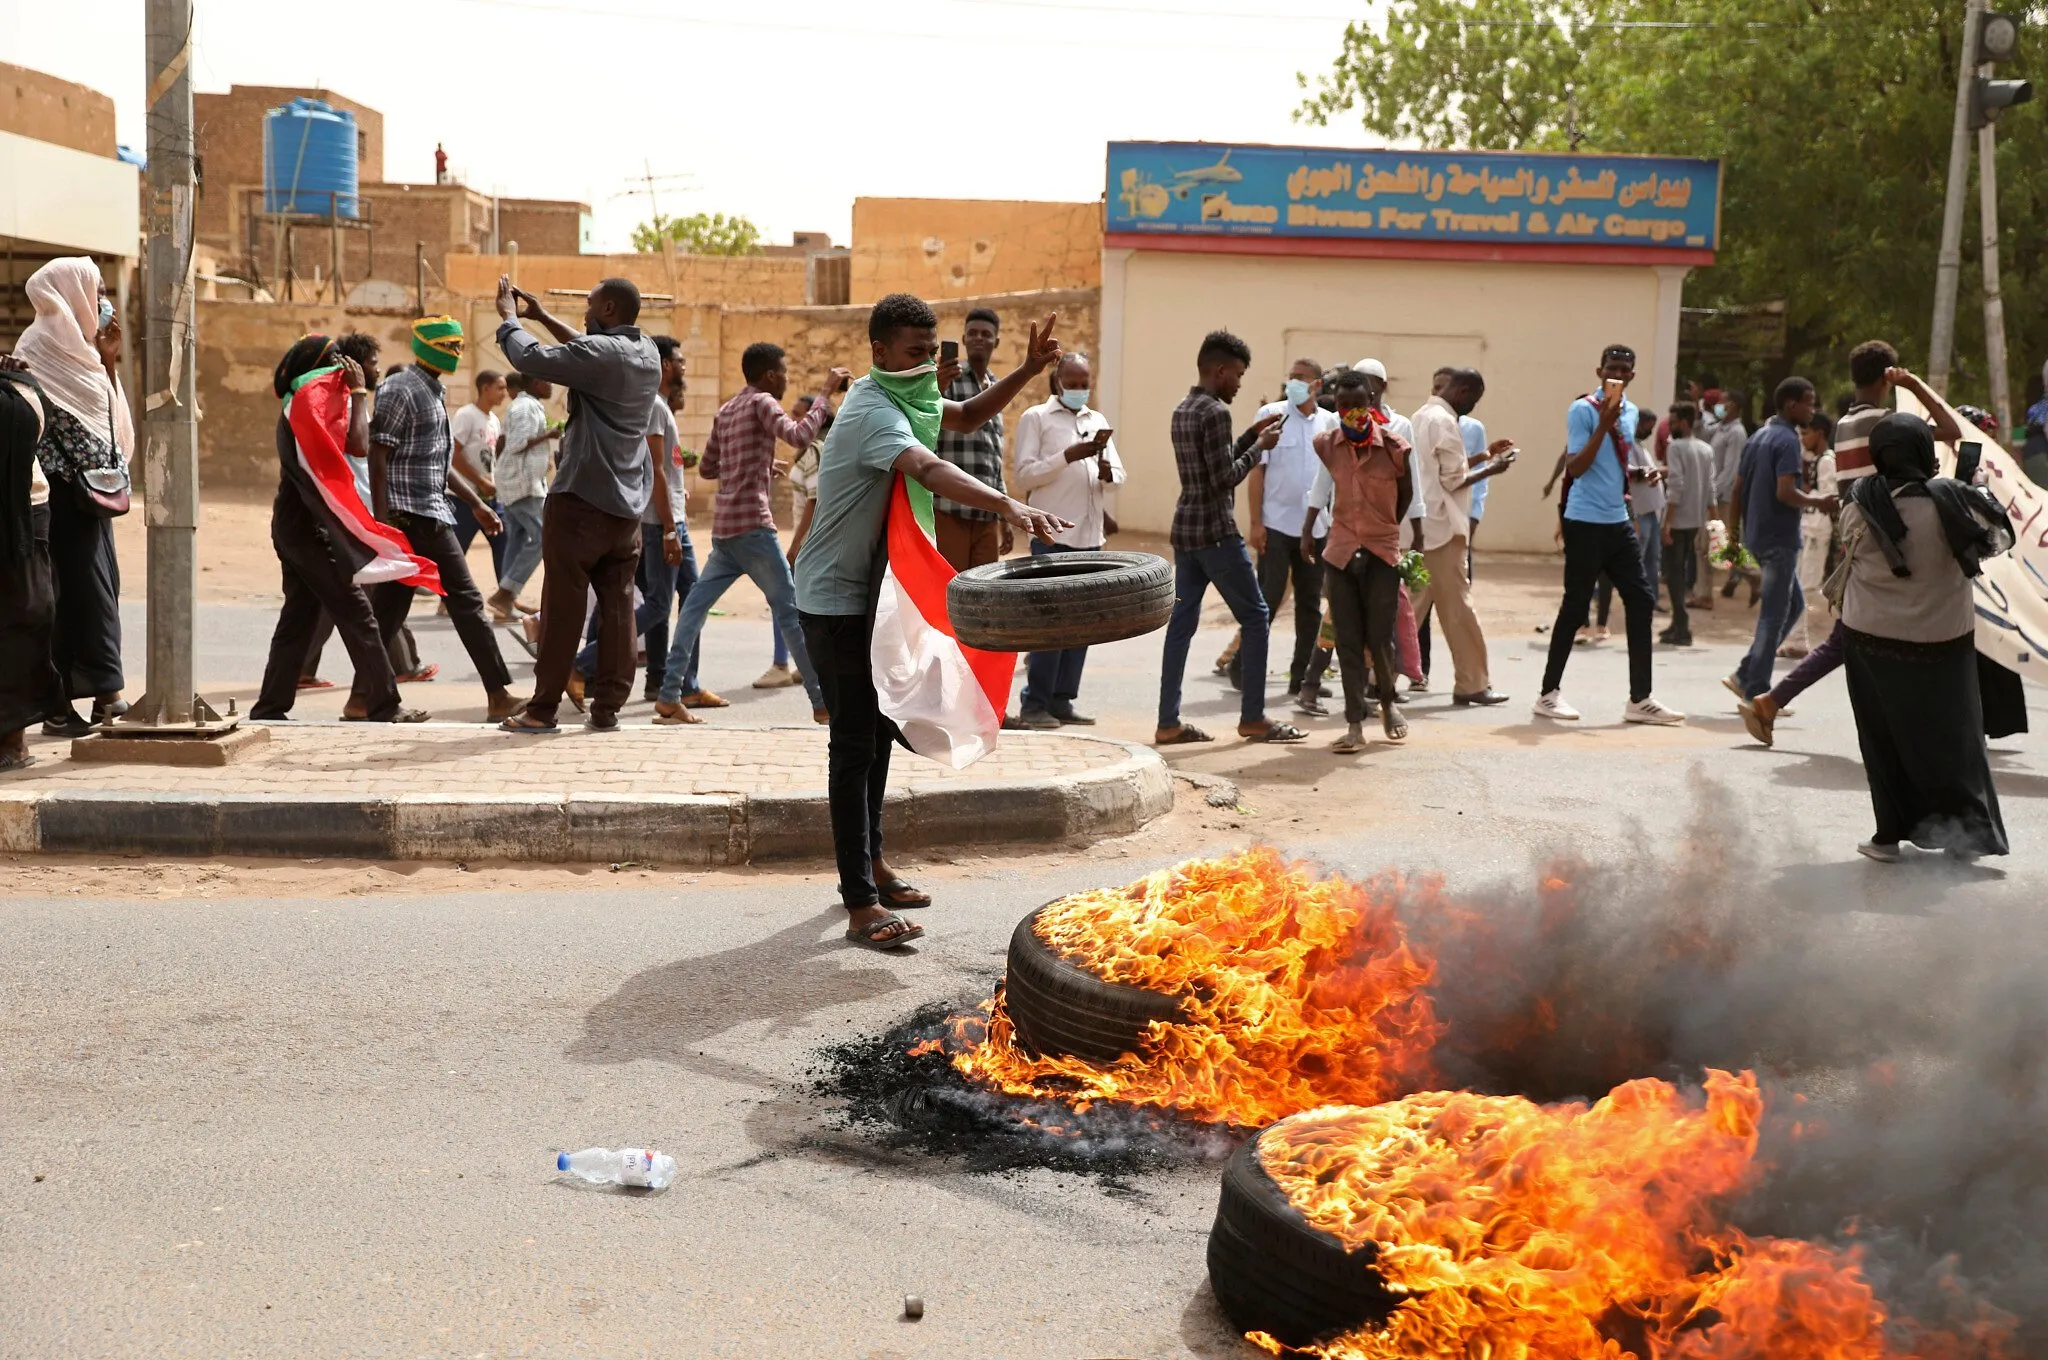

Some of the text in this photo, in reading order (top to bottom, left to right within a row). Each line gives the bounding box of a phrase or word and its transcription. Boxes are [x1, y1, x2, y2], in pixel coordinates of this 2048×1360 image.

[1287, 161, 1352, 200] الجوي
[1356, 161, 1445, 201] والشحن
[1447, 163, 1550, 205] والسياحة
[1550, 166, 1617, 206] للسفر
[1379, 207, 1427, 230] For
[1430, 208, 1520, 232] Travel
[1526, 211, 1549, 234] &
[1555, 212, 1599, 235] Air
[1604, 213, 1687, 242] Cargo
